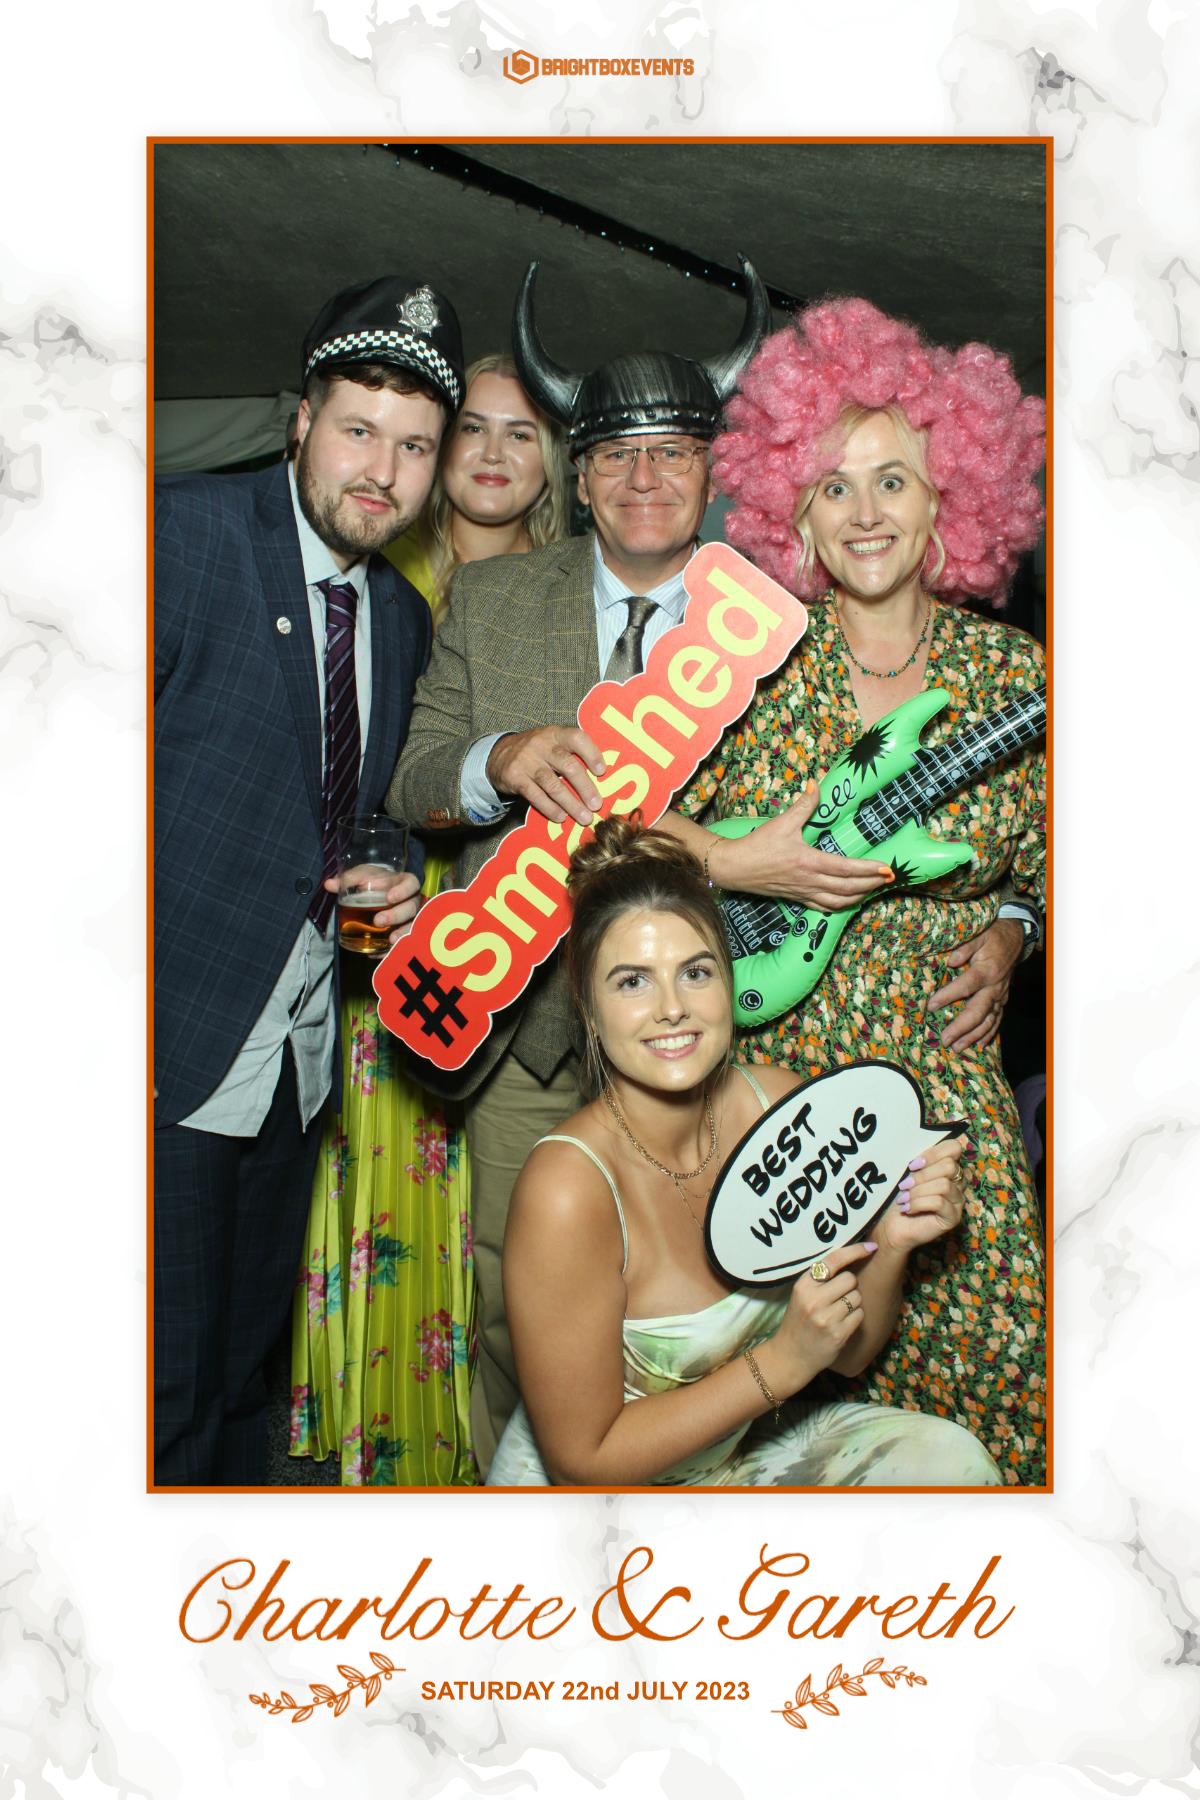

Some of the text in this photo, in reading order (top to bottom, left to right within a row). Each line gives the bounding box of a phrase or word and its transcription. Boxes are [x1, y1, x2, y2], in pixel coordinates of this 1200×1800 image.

[806, 778, 857, 828] oll
[741, 1102, 816, 1197] BEST
[750, 1106, 877, 1247] WEDDING
[813, 1161, 888, 1243] EVER
